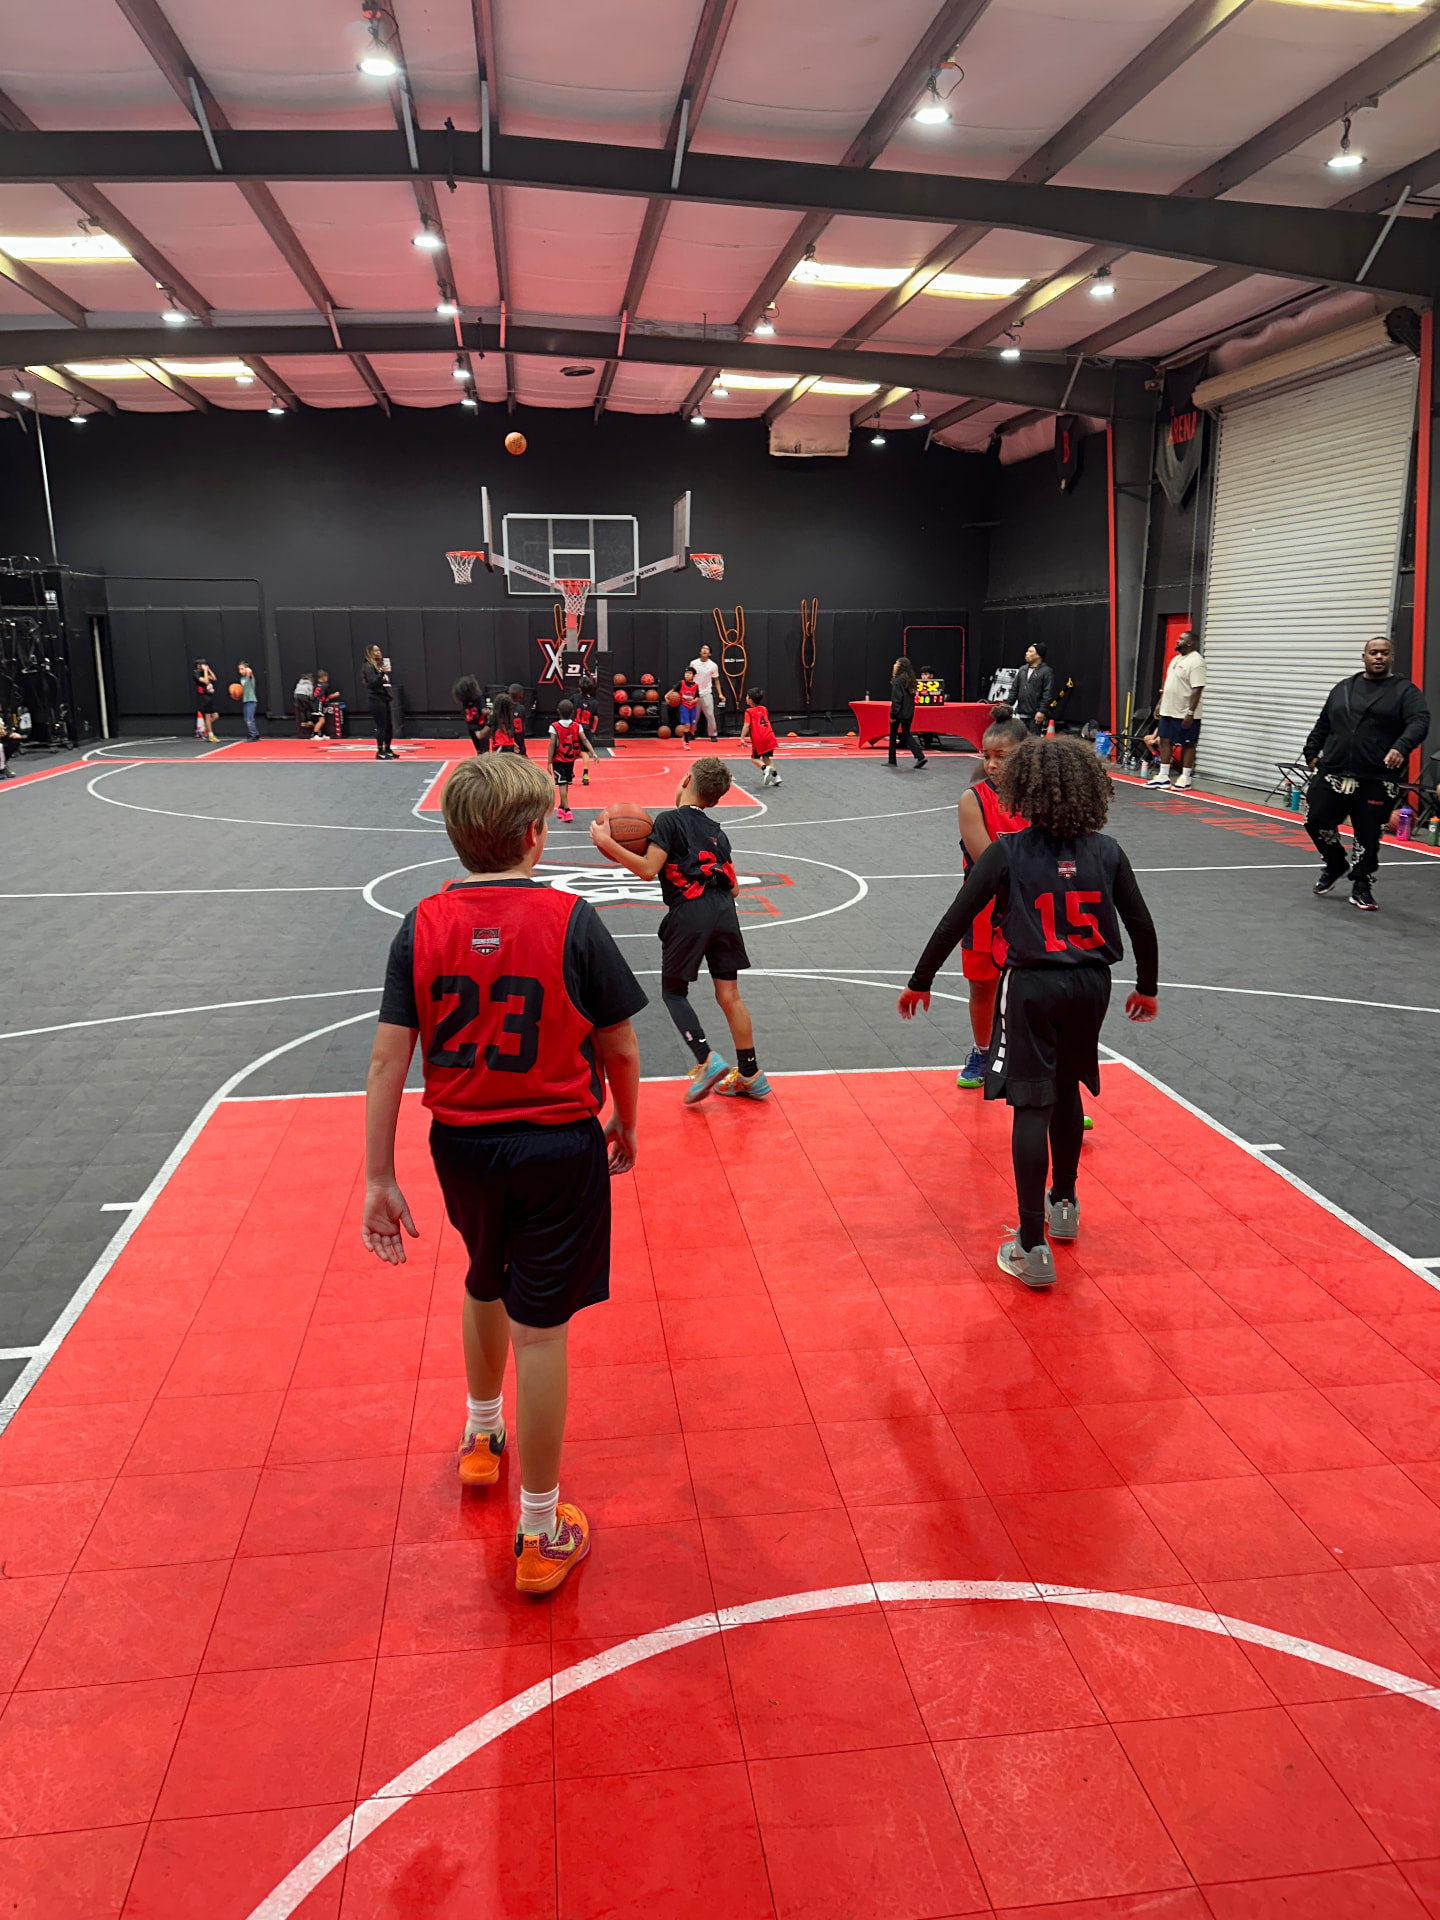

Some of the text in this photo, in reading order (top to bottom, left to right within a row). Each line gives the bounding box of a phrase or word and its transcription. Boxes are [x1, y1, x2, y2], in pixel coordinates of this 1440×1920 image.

[575, 708, 590, 725] 18
[1034, 891, 1106, 953] 15
[427, 975, 544, 1073] 23
